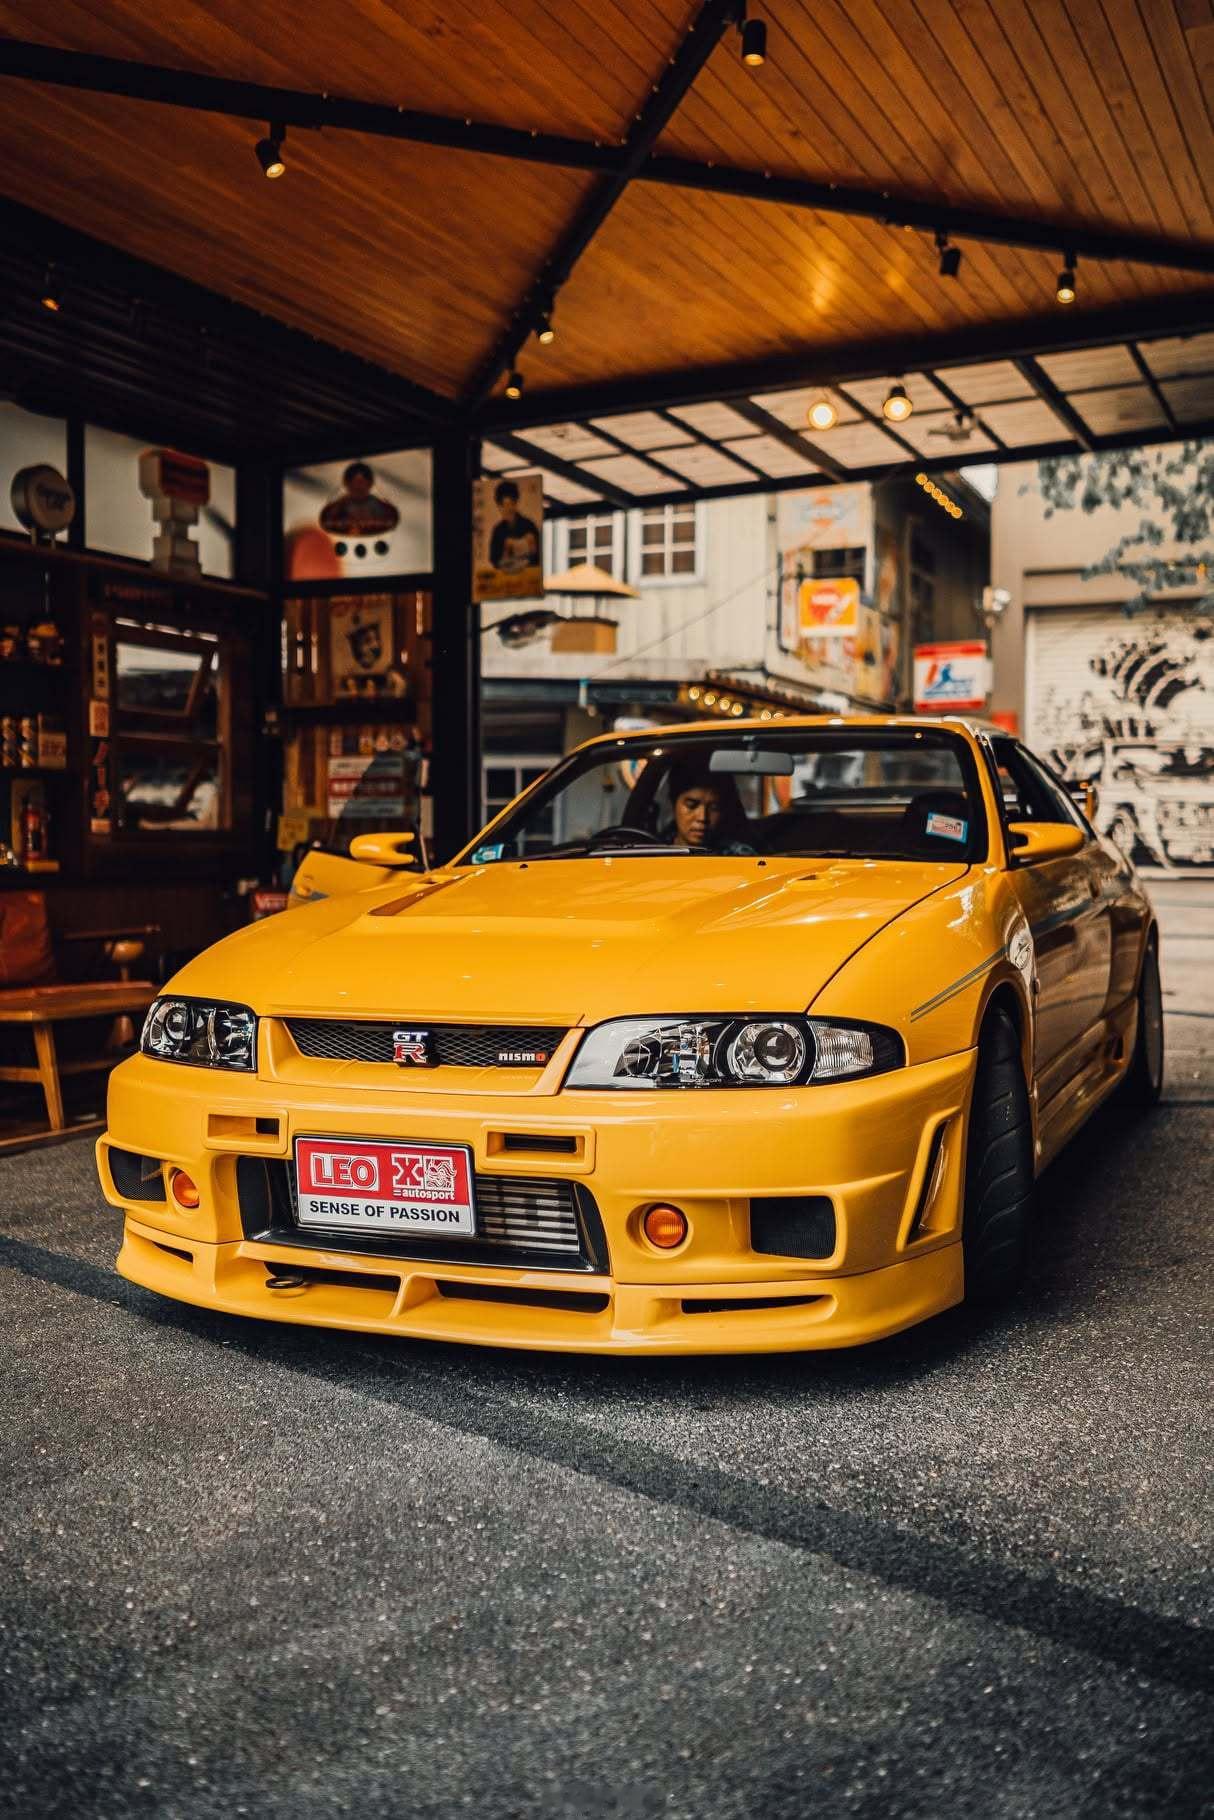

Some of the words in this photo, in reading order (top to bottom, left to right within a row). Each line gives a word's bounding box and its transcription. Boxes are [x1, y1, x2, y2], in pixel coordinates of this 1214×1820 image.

[393, 1031, 429, 1042] GT
[393, 1043, 427, 1063] R
[498, 1052, 546, 1062] nismo
[312, 1153, 378, 1190] LEO
[402, 1188, 455, 1200] autosport
[310, 1200, 361, 1216] SENSE
[365, 1205, 385, 1218] OF
[390, 1207, 460, 1223] PASSION
